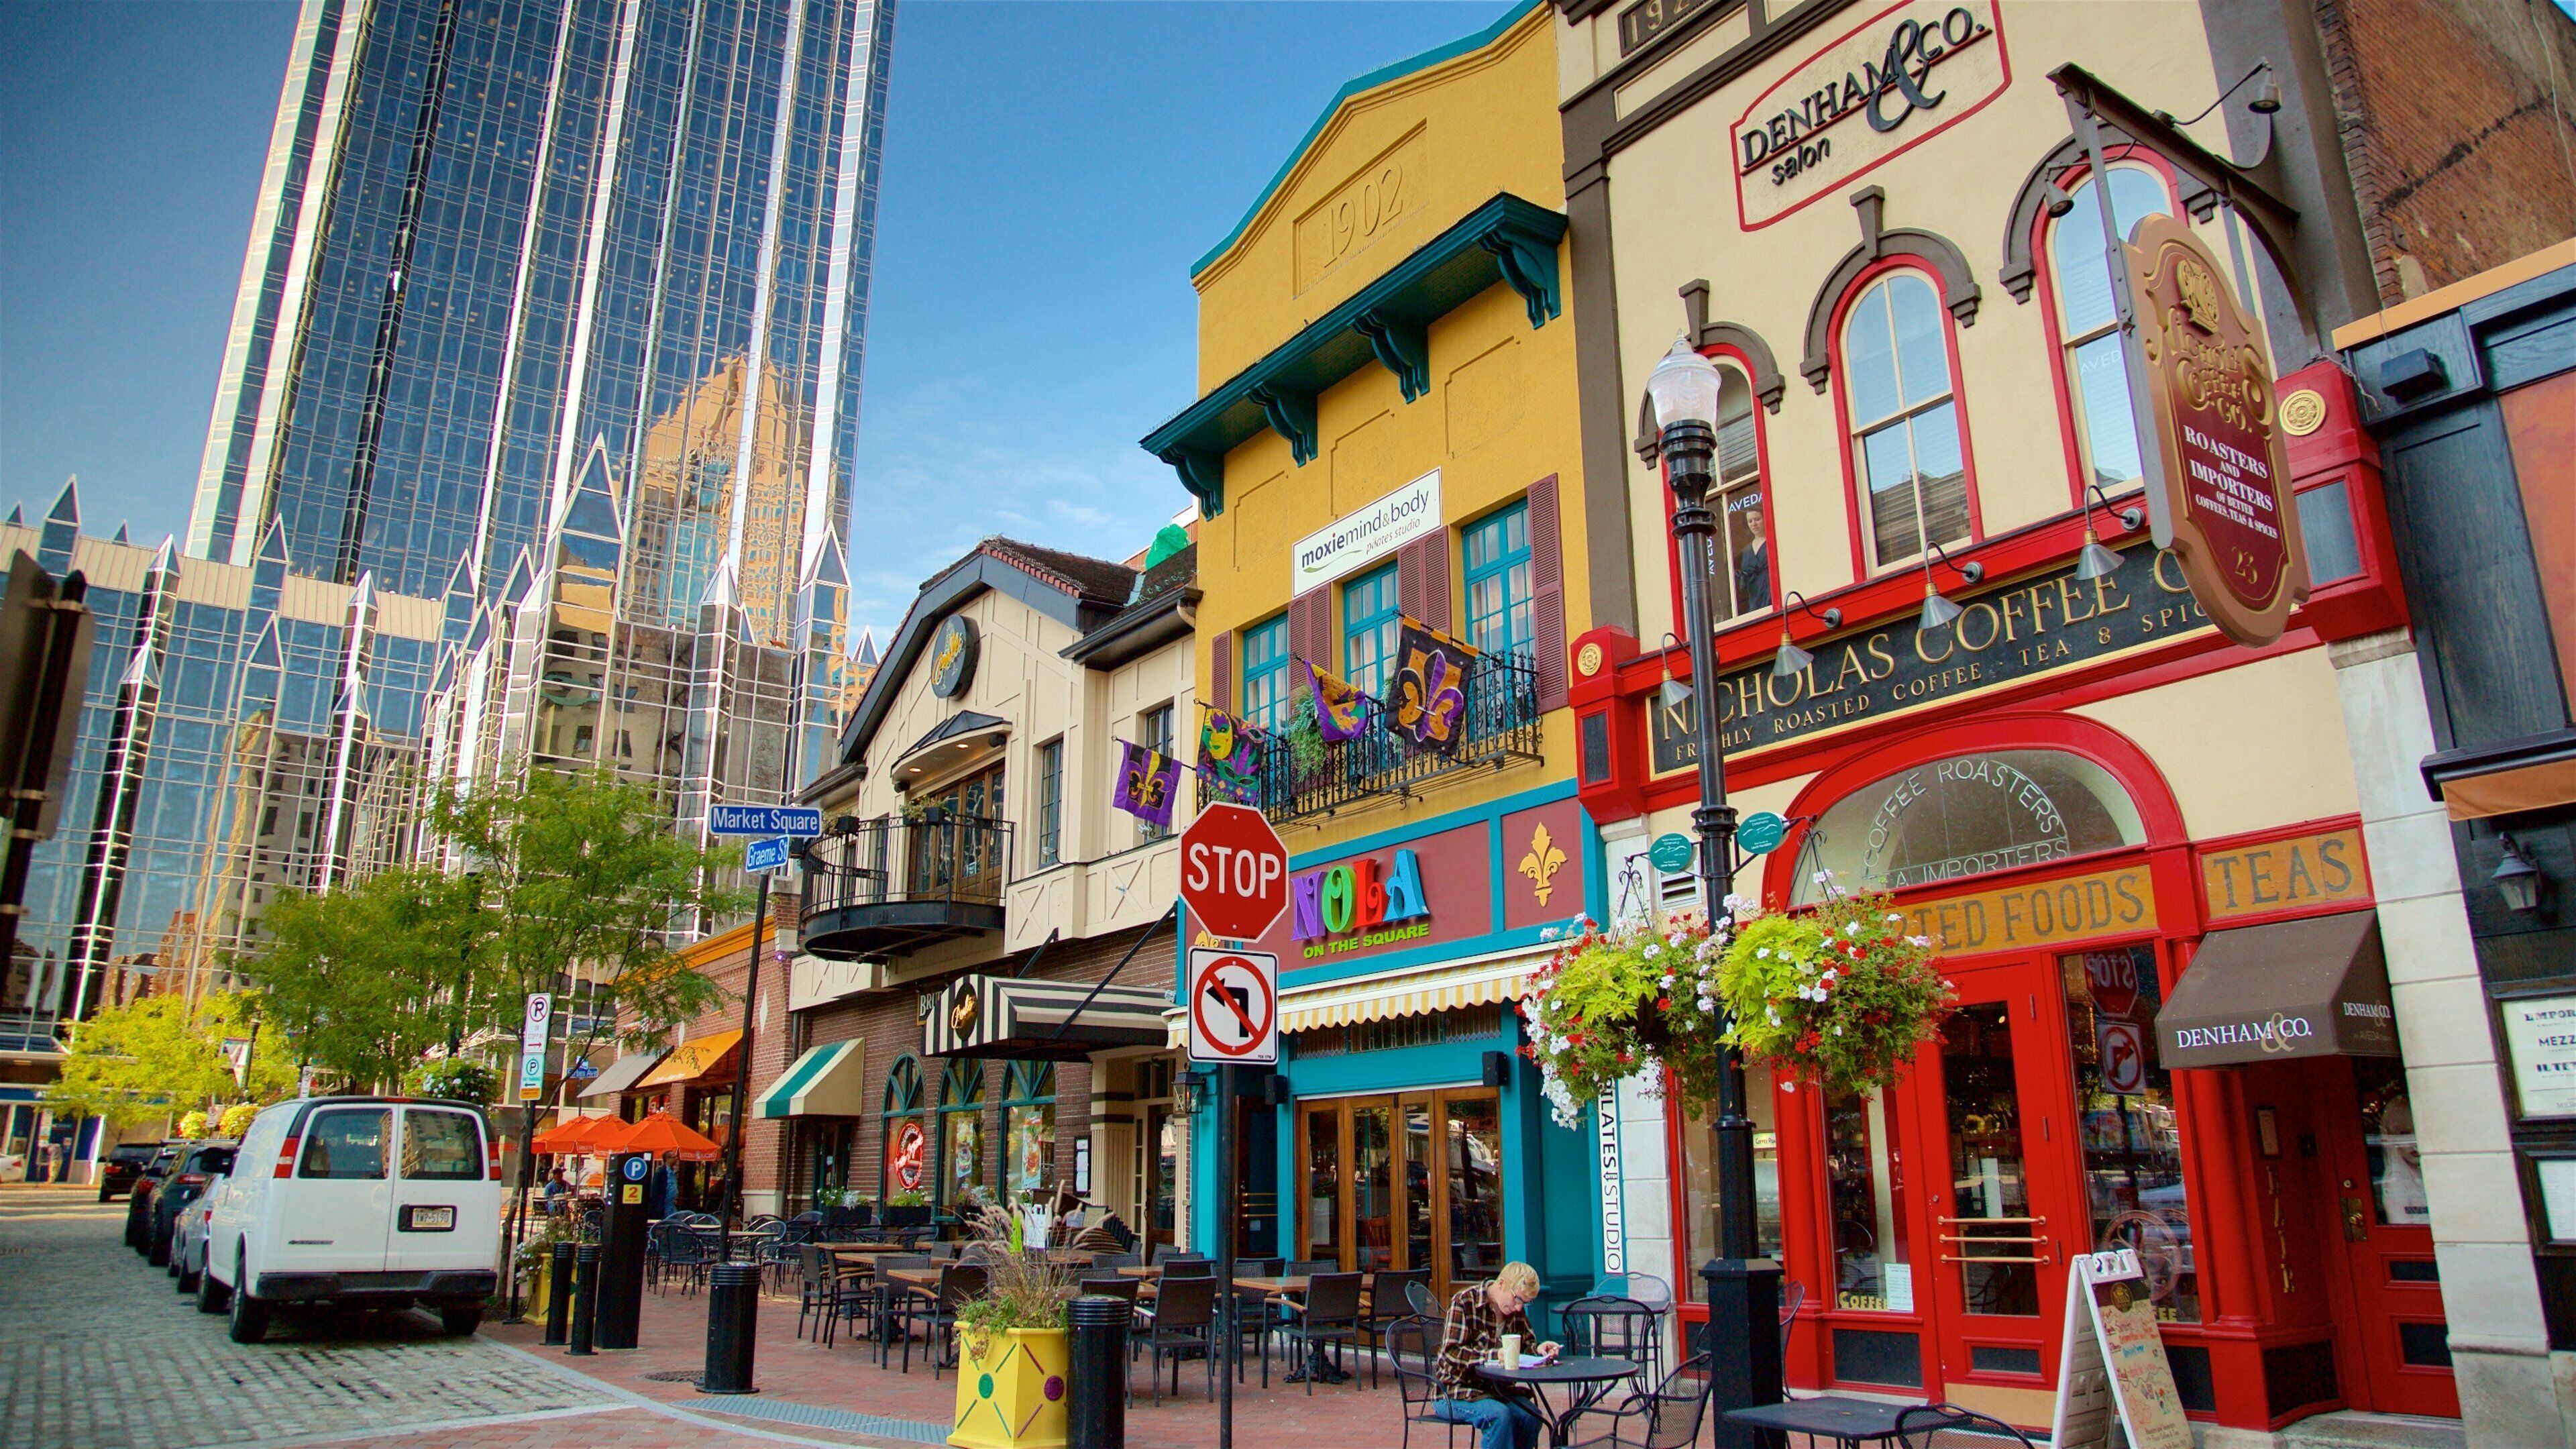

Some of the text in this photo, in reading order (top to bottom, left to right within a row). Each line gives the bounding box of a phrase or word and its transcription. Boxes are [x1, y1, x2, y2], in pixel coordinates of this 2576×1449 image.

[1771, 138, 1831, 186] salon
[1324, 162, 1403, 268] 1902
[2176, 358, 2241, 411] COFFEE
[2217, 397, 2253, 433] CO.
[2183, 425, 2268, 479] ROASTERS
[2220, 460, 2240, 478] AND
[2190, 459, 2273, 512] IMPORTERS
[2216, 491, 2255, 516] OF BETTER
[1366, 518, 1420, 555] pilates studio
[2229, 508, 2247, 525] TEAS
[2248, 518, 2254, 529] &
[2254, 519, 2278, 539] SPICES
[2231, 547, 2258, 584] 23
[1915, 572, 2131, 664] COFFEE
[1676, 601, 2208, 761] FRHLY ROASTED COFFEE TEA & SPIC
[713, 808, 818, 834] Market Square
[1864, 759, 2059, 867] COFFEE ROASTERS
[747, 839, 788, 867] Graeme St
[1187, 843, 1281, 899] STOP
[2213, 839, 2353, 908] TEAS
[1290, 849, 1430, 942] NOLA
[2000, 873, 2144, 942] FOODS
[1303, 923, 1430, 959] ON THE SQUARE
[628, 1186, 639, 1198] 2
[1604, 1185, 1621, 1271] STUDIO
